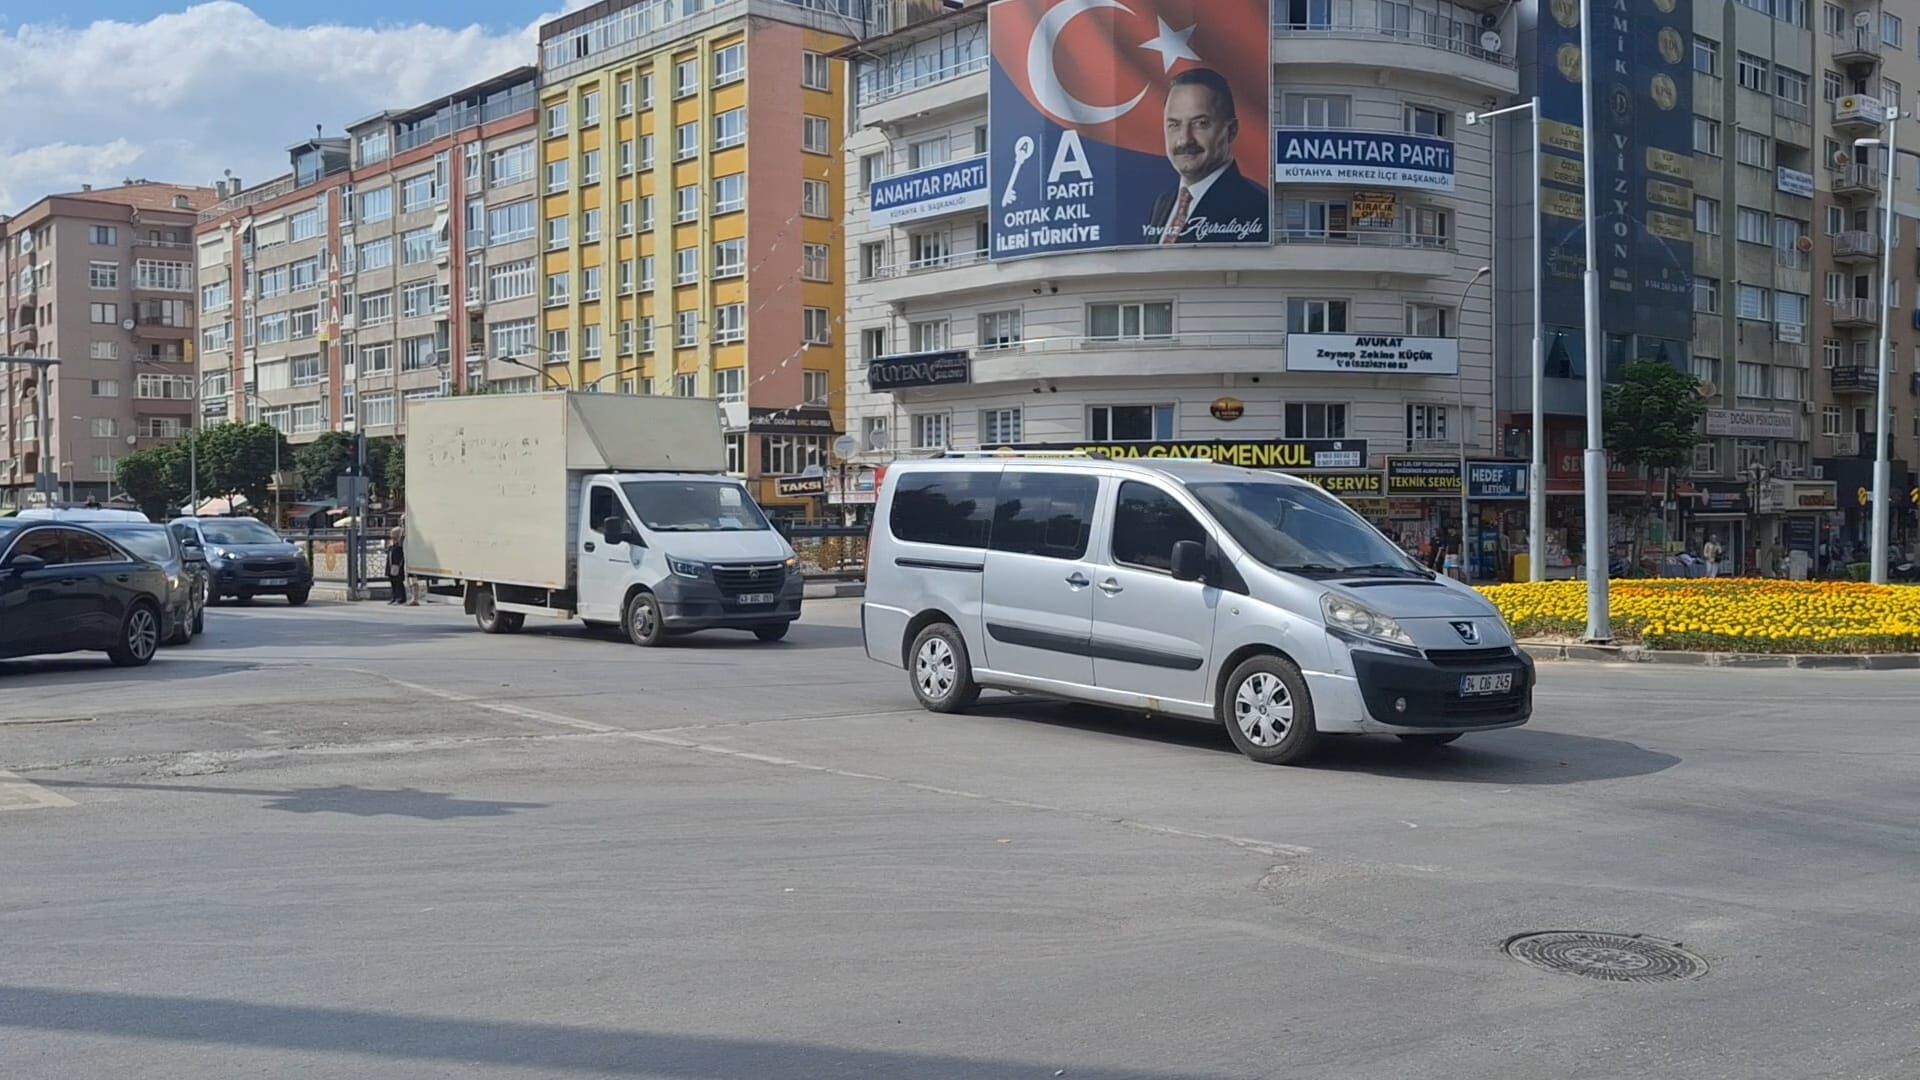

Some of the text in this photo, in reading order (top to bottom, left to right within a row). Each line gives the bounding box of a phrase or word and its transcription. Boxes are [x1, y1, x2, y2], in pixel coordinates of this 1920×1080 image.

[1048, 130, 1094, 182] A
[1285, 138, 1450, 168] ANAHTAR PARTİ
[1285, 167, 1449, 185] KÜTAHYA MERKEZ İLÇE BAŞKANLIĞI
[874, 165, 984, 207] ANAHTAR PARTİ
[1047, 181, 1094, 200] PARTİ
[1613, 133, 1628, 259] VİZYON
[1004, 203, 1091, 227] ORTAK AKIL
[996, 223, 1100, 252] İLERİ TÜRKİYE
[1142, 217, 1263, 240] Yavuz Ağıralioğlu
[1355, 337, 1404, 347] AVUKAT
[1316, 349, 1433, 362] Zeynep Zekine KÜÇÜK
[1327, 474, 1379, 491] SERVİS
[1390, 475, 1462, 488] TEKNİK SERVİS
[1471, 468, 1504, 482] HEDEF
[1495, 675, 1511, 689] 245
